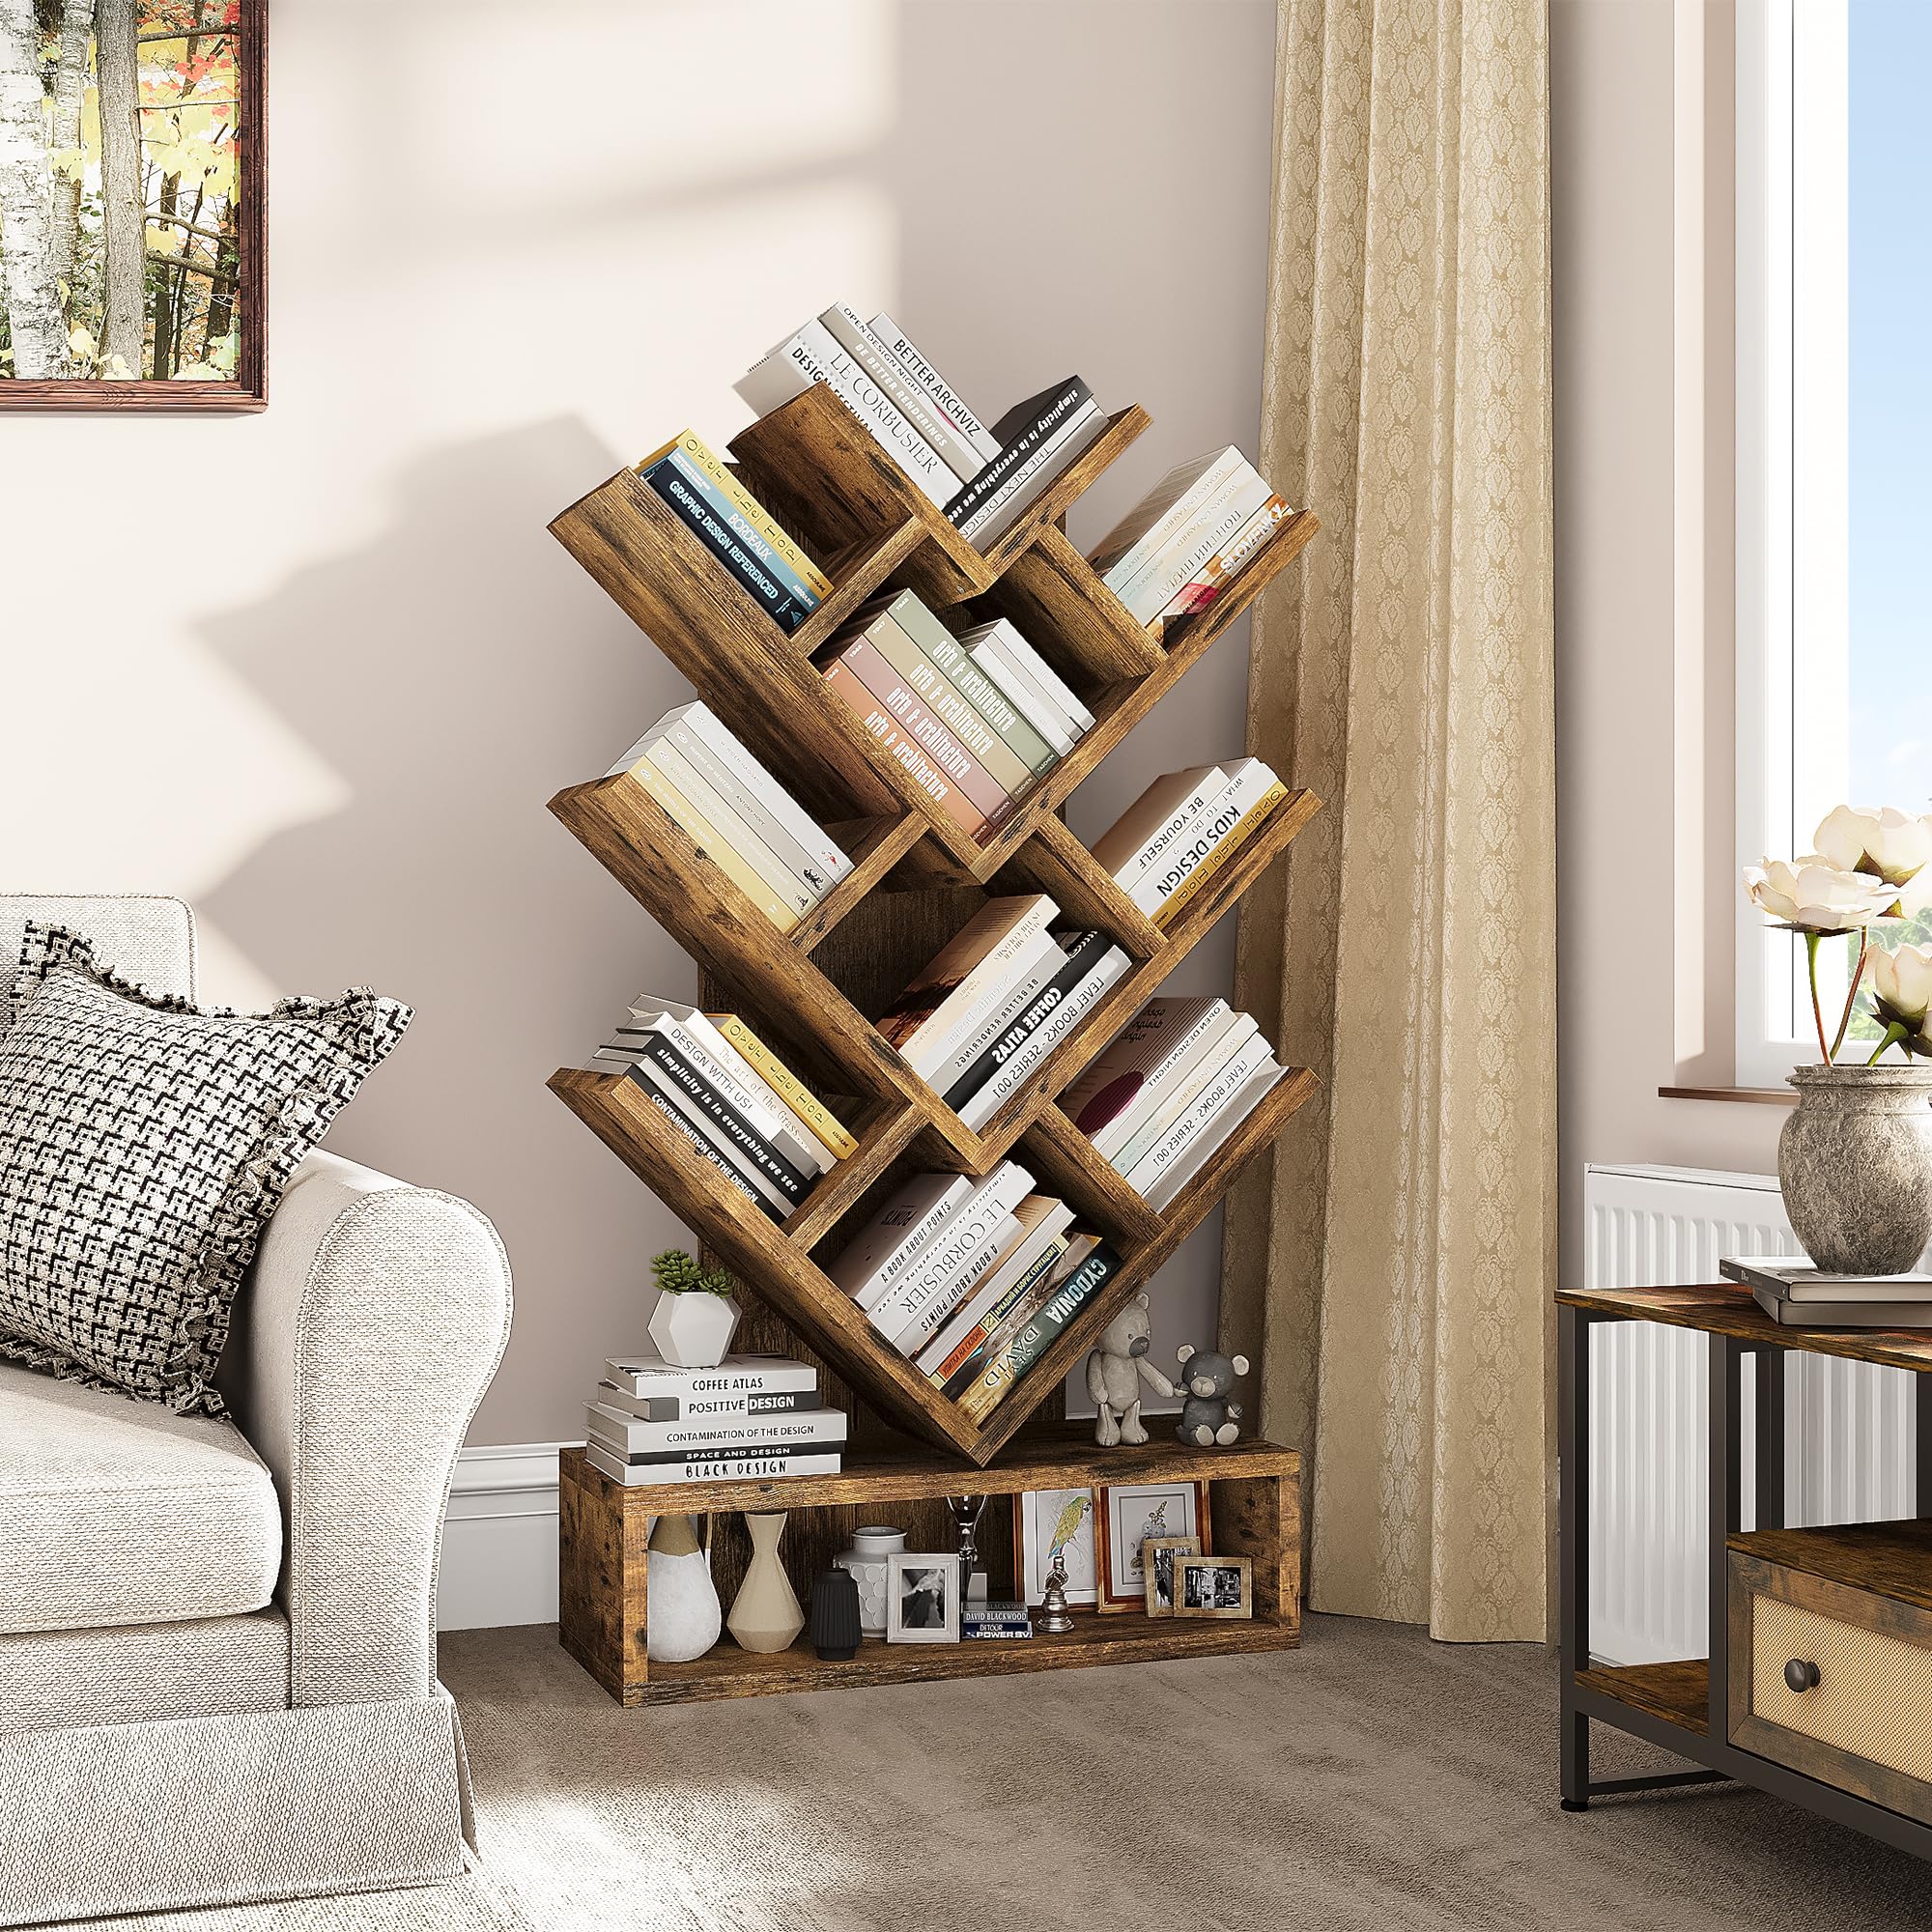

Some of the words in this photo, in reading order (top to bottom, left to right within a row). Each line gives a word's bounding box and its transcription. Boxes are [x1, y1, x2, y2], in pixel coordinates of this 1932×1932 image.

[843, 307, 867, 333] OPEN
[866, 329, 896, 361] DESIGN
[895, 360, 923, 396] NIGHT
[854, 343, 871, 360] BE
[867, 357, 897, 392] BETTER
[895, 390, 948, 448] RENDERINGS
[893, 338, 937, 387] BETTER
[930, 384, 981, 438] ARCHVIZ
[830, 353, 854, 381] LE
[852, 378, 939, 474] CORBUSIER
[1037, 389, 1079, 433] simplicity
[1018, 440, 1030, 452] in
[1028, 429, 1038, 441] is
[975, 449, 1019, 496] everything
[1028, 446, 1052, 470] THE
[1000, 468, 1029, 498] NEXT
[946, 505, 963, 524] see
[963, 492, 977, 507] we
[668, 480, 706, 520] GRAPHIC
[701, 515, 733, 551] DESIGN
[728, 545, 779, 600] REFERENCED
[727, 513, 773, 561] BORDEAUX
[1194, 510, 1242, 561] ПОНТИЙ
[932, 639, 958, 668] arts
[951, 661, 966, 676] &
[959, 669, 1016, 732] architecture
[909, 664, 934, 692] arts
[928, 684, 944, 700] &
[937, 694, 994, 755] architecture
[886, 687, 912, 716] arts
[905, 707, 922, 724] &
[914, 717, 972, 780] architecture
[864, 710, 889, 738] arts
[892, 741, 949, 802] architecture
[1037, 753, 1056, 773] TASCHEN
[1013, 777, 1033, 797] TASCHEN
[1221, 778, 1244, 802] WHAT
[991, 800, 1010, 820] TASCHEN
[1187, 796, 1205, 814] BE
[1206, 805, 1218, 818] TO
[972, 824, 987, 840] SCHEN
[1191, 819, 1205, 835] DO
[1207, 806, 1241, 844] KIDS
[1139, 813, 1190, 869] YOURSELF
[1156, 838, 1210, 897] DESIGN
[670, 1028, 709, 1067] DESIGN
[708, 1064, 735, 1094] WITH
[734, 1091, 753, 1112] US!
[719, 1046, 733, 1065] The
[732, 1065, 751, 1082] art
[750, 1081, 764, 1095] of
[762, 1094, 778, 1113] the
[656, 1048, 704, 1095] simplicity
[701, 1093, 712, 1105] is
[710, 1102, 723, 1115] in
[721, 1113, 770, 1164] everything
[767, 1159, 782, 1176] we
[781, 1174, 798, 1192] see
[651, 1094, 711, 1155] CONTAMINATION
[707, 1151, 720, 1164] OF
[717, 1160, 733, 1179] THE
[730, 1173, 758, 1204] DESIGN
[968, 1173, 1006, 1214] simplicity
[981, 1199, 1007, 1226] LE
[881, 1273, 889, 1283] A
[888, 1252, 907, 1276] BOOK
[905, 1228, 928, 1255] ABOUT
[927, 1201, 952, 1231] POINTS
[949, 1227, 957, 1236] in
[904, 1236, 947, 1282] everything
[970, 1251, 992, 1277] BOOK
[991, 1243, 999, 1254] A
[899, 1222, 986, 1315] CORBUSIER
[994, 1290, 1017, 1316] АРКАДИЙ
[1017, 1272, 1034, 1292] БОРИС
[1031, 1245, 1058, 1278] СТРУГАЦКИЕ
[893, 1285, 904, 1296] we
[949, 1273, 972, 1303] ABOUT
[1045, 1258, 1107, 1324] CYDONIA
[877, 1298, 891, 1314] see
[920, 1300, 949, 1331] POINTS
[984, 1325, 1040, 1388] DAVID
[1005, 1349, 1035, 1380] SEYI
[692, 1379, 728, 1391] COFFEE
[732, 1378, 763, 1389] ATLAS
[689, 1400, 746, 1414] POSITIVE
[749, 1396, 795, 1410] DESIGN
[667, 1430, 743, 1443] CONTAMINATION
[747, 1429, 759, 1438] OF
[760, 1428, 778, 1437] THE
[780, 1425, 814, 1435] DESIGN
[686, 1452, 720, 1461] SPACE
[751, 1448, 790, 1457] DESIGN
[686, 1463, 728, 1478] BLACK
[737, 1461, 787, 1475] DESIGN
[966, 1612, 985, 1621] DAVID
[986, 1612, 1027, 1621] BLACKWOOD
